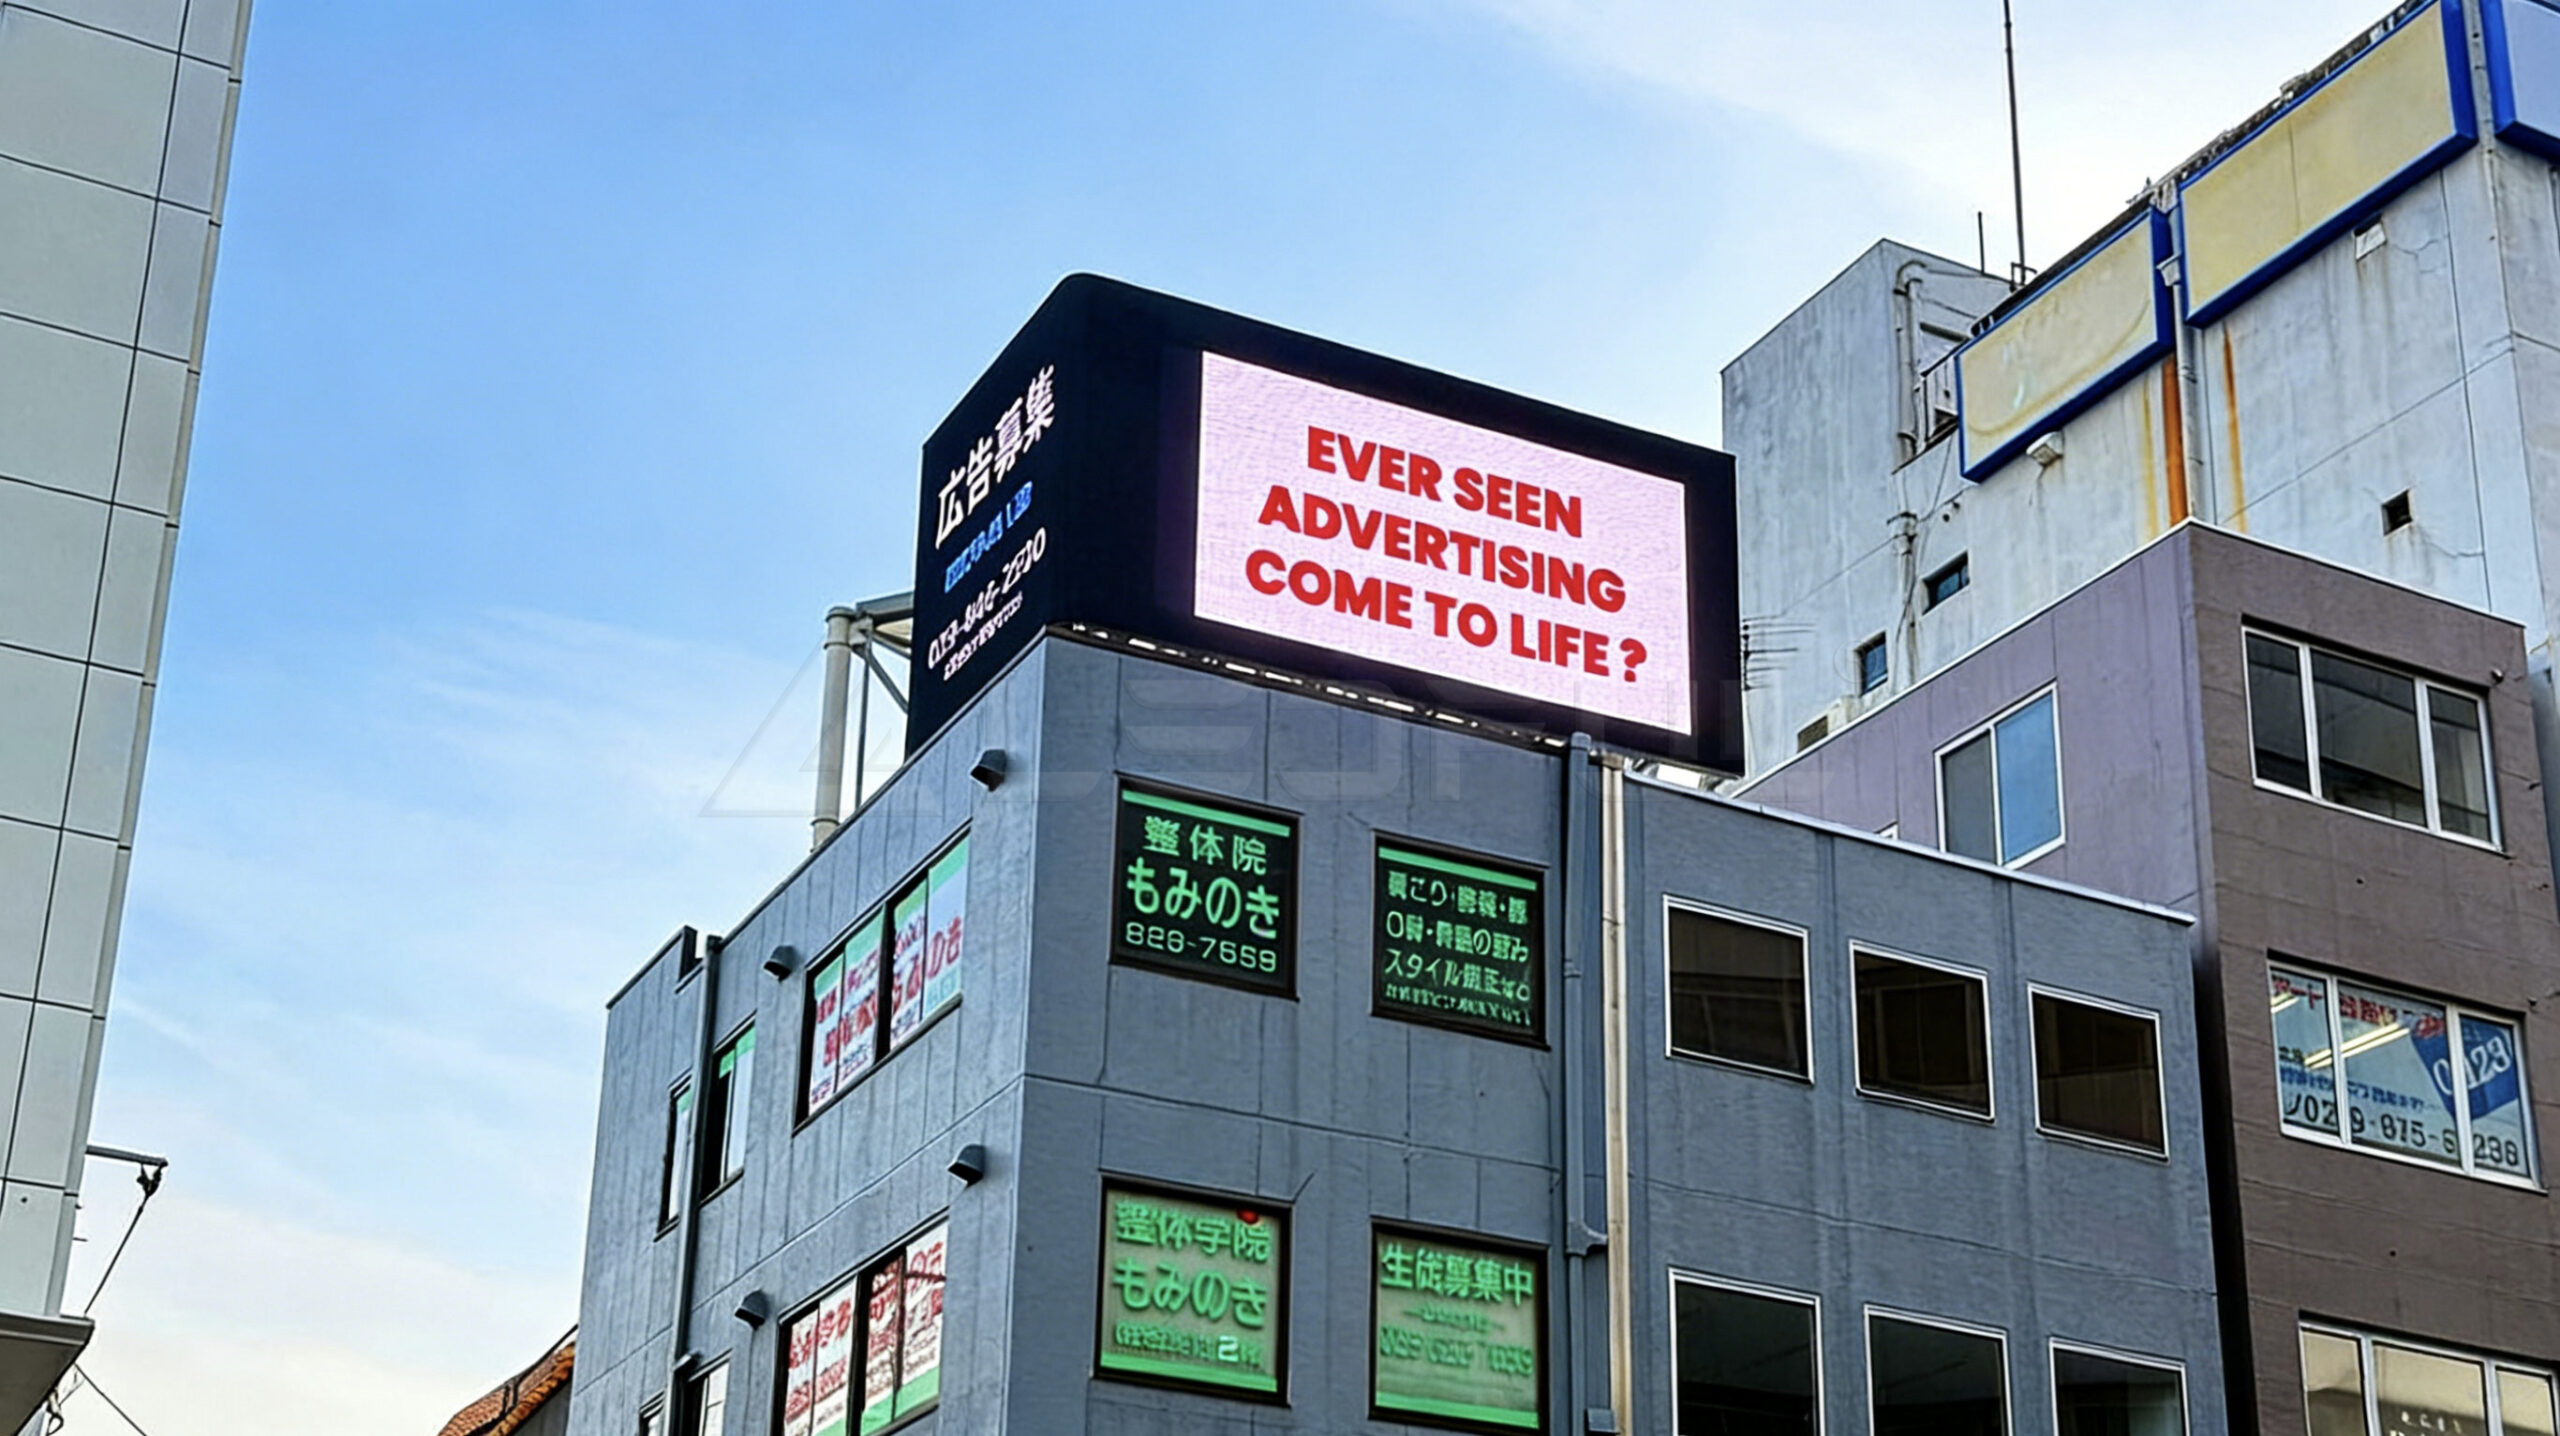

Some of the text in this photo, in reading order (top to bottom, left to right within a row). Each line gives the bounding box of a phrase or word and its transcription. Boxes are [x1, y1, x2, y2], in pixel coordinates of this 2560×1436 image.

[935, 364, 1056, 550] 広告募集
[1308, 426, 1581, 537] EVER SEEN
[1258, 485, 1625, 613] ADVERTISING
[1246, 550, 1412, 629] COME
[1425, 591, 1497, 647] TO
[1511, 614, 1609, 676] LIFE
[1143, 815, 1267, 875] 整体院
[1126, 857, 1280, 939] もみのき
[1115, 1200, 1271, 1262] 整体学院
[1113, 1256, 1268, 1328] もみのき
